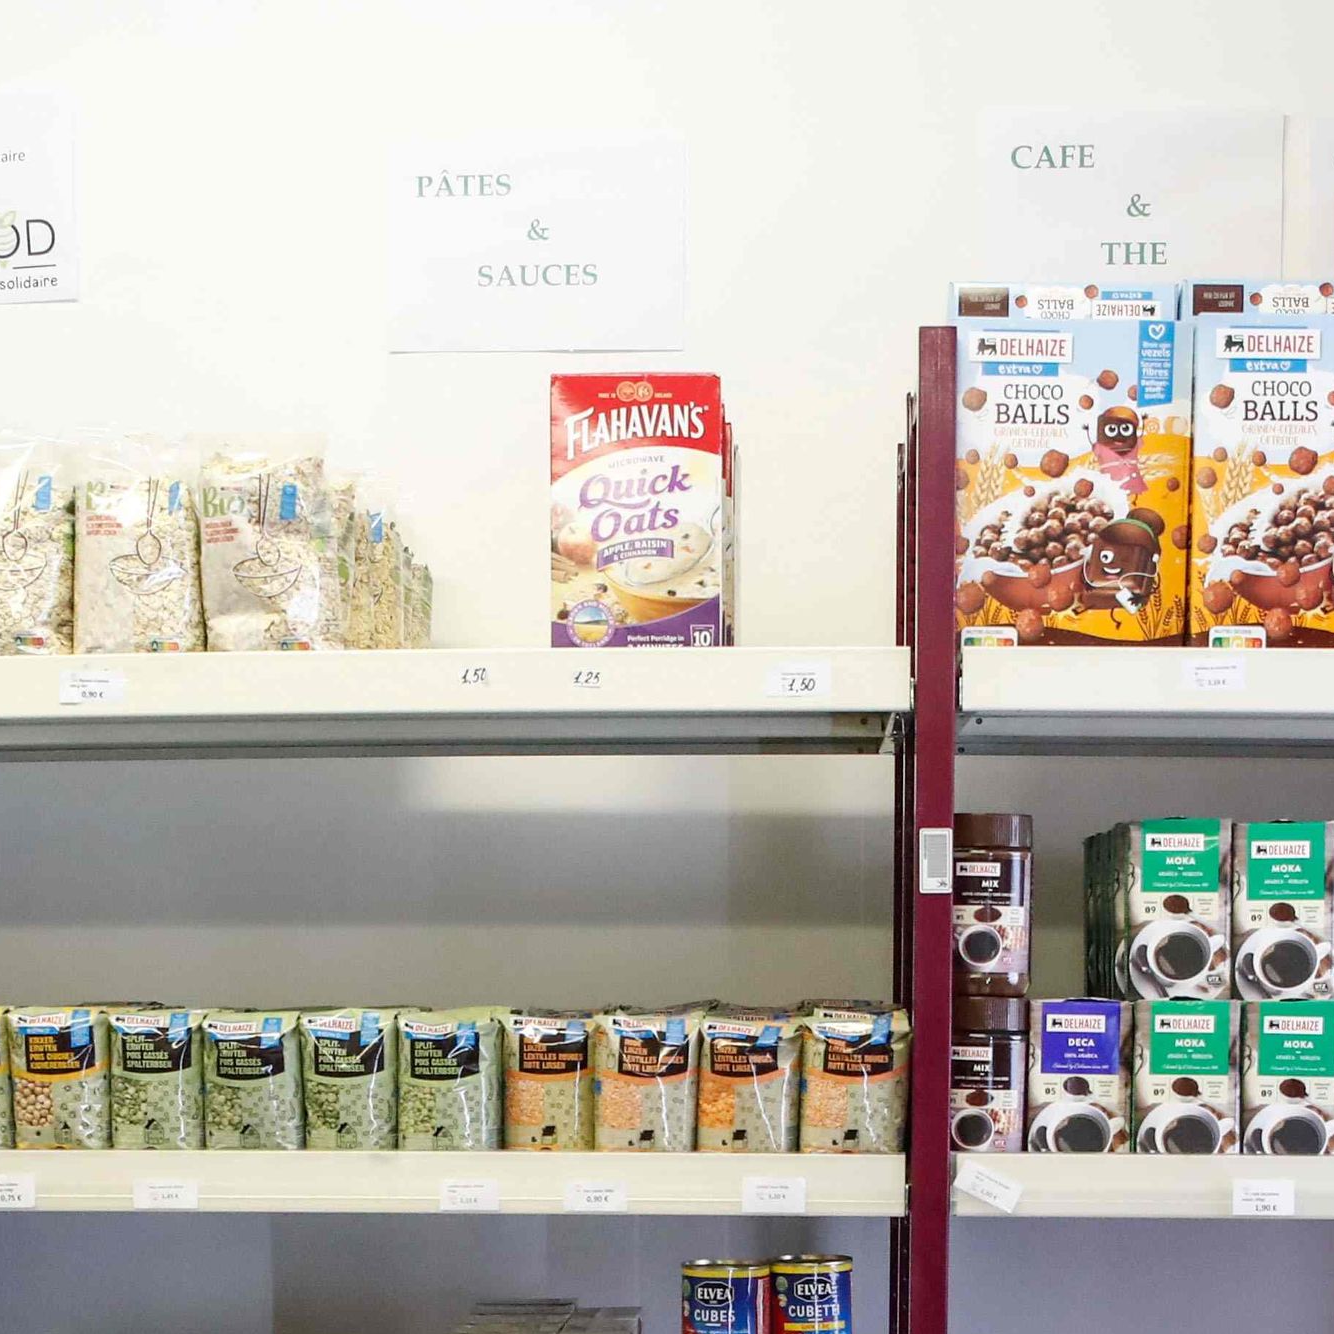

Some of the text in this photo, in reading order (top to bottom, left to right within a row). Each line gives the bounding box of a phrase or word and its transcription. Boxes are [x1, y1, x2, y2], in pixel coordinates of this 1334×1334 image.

[1009, 145, 1095, 169] CAFE
[415, 170, 512, 198] PÂTES
[1125, 193, 1151, 217] &
[527, 218, 550, 241] &
[1100, 241, 1168, 266] THE
[477, 262, 599, 287] SAUCES
[0, 275, 58, 290] solidaire
[999, 338, 1066, 356] DELHAIZE
[1247, 333, 1314, 354] DELHAIZE
[1003, 384, 1063, 400] CHOCO
[1251, 381, 1312, 398] CHOCO
[995, 404, 1070, 425] BALLS
[1243, 401, 1318, 422] BALLS
[564, 401, 706, 461] FLAHAVAN'S
[608, 455, 665, 469] MICROWAVE
[579, 465, 692, 512] Quick
[591, 501, 679, 542] Oats
[634, 539, 667, 549] RAISIN
[693, 631, 711, 645] 10
[574, 672, 600, 685] 1,25
[788, 679, 815, 691] 1,50
[1163, 838, 1201, 848] DELHAIZE
[1166, 857, 1195, 865] MOKA
[1271, 864, 1301, 872] MOKA
[981, 880, 999, 888] MIX
[1065, 1018, 1102, 1029] DELHAIZE
[1068, 1038, 1095, 1047] DECA
[1175, 1039, 1205, 1047] MOKA
[587, 1195, 602, 1203] 0,90
[1255, 1204, 1269, 1212] 1,90
[697, 1286, 732, 1301] ELVEA
[695, 1308, 735, 1322] CUBES
